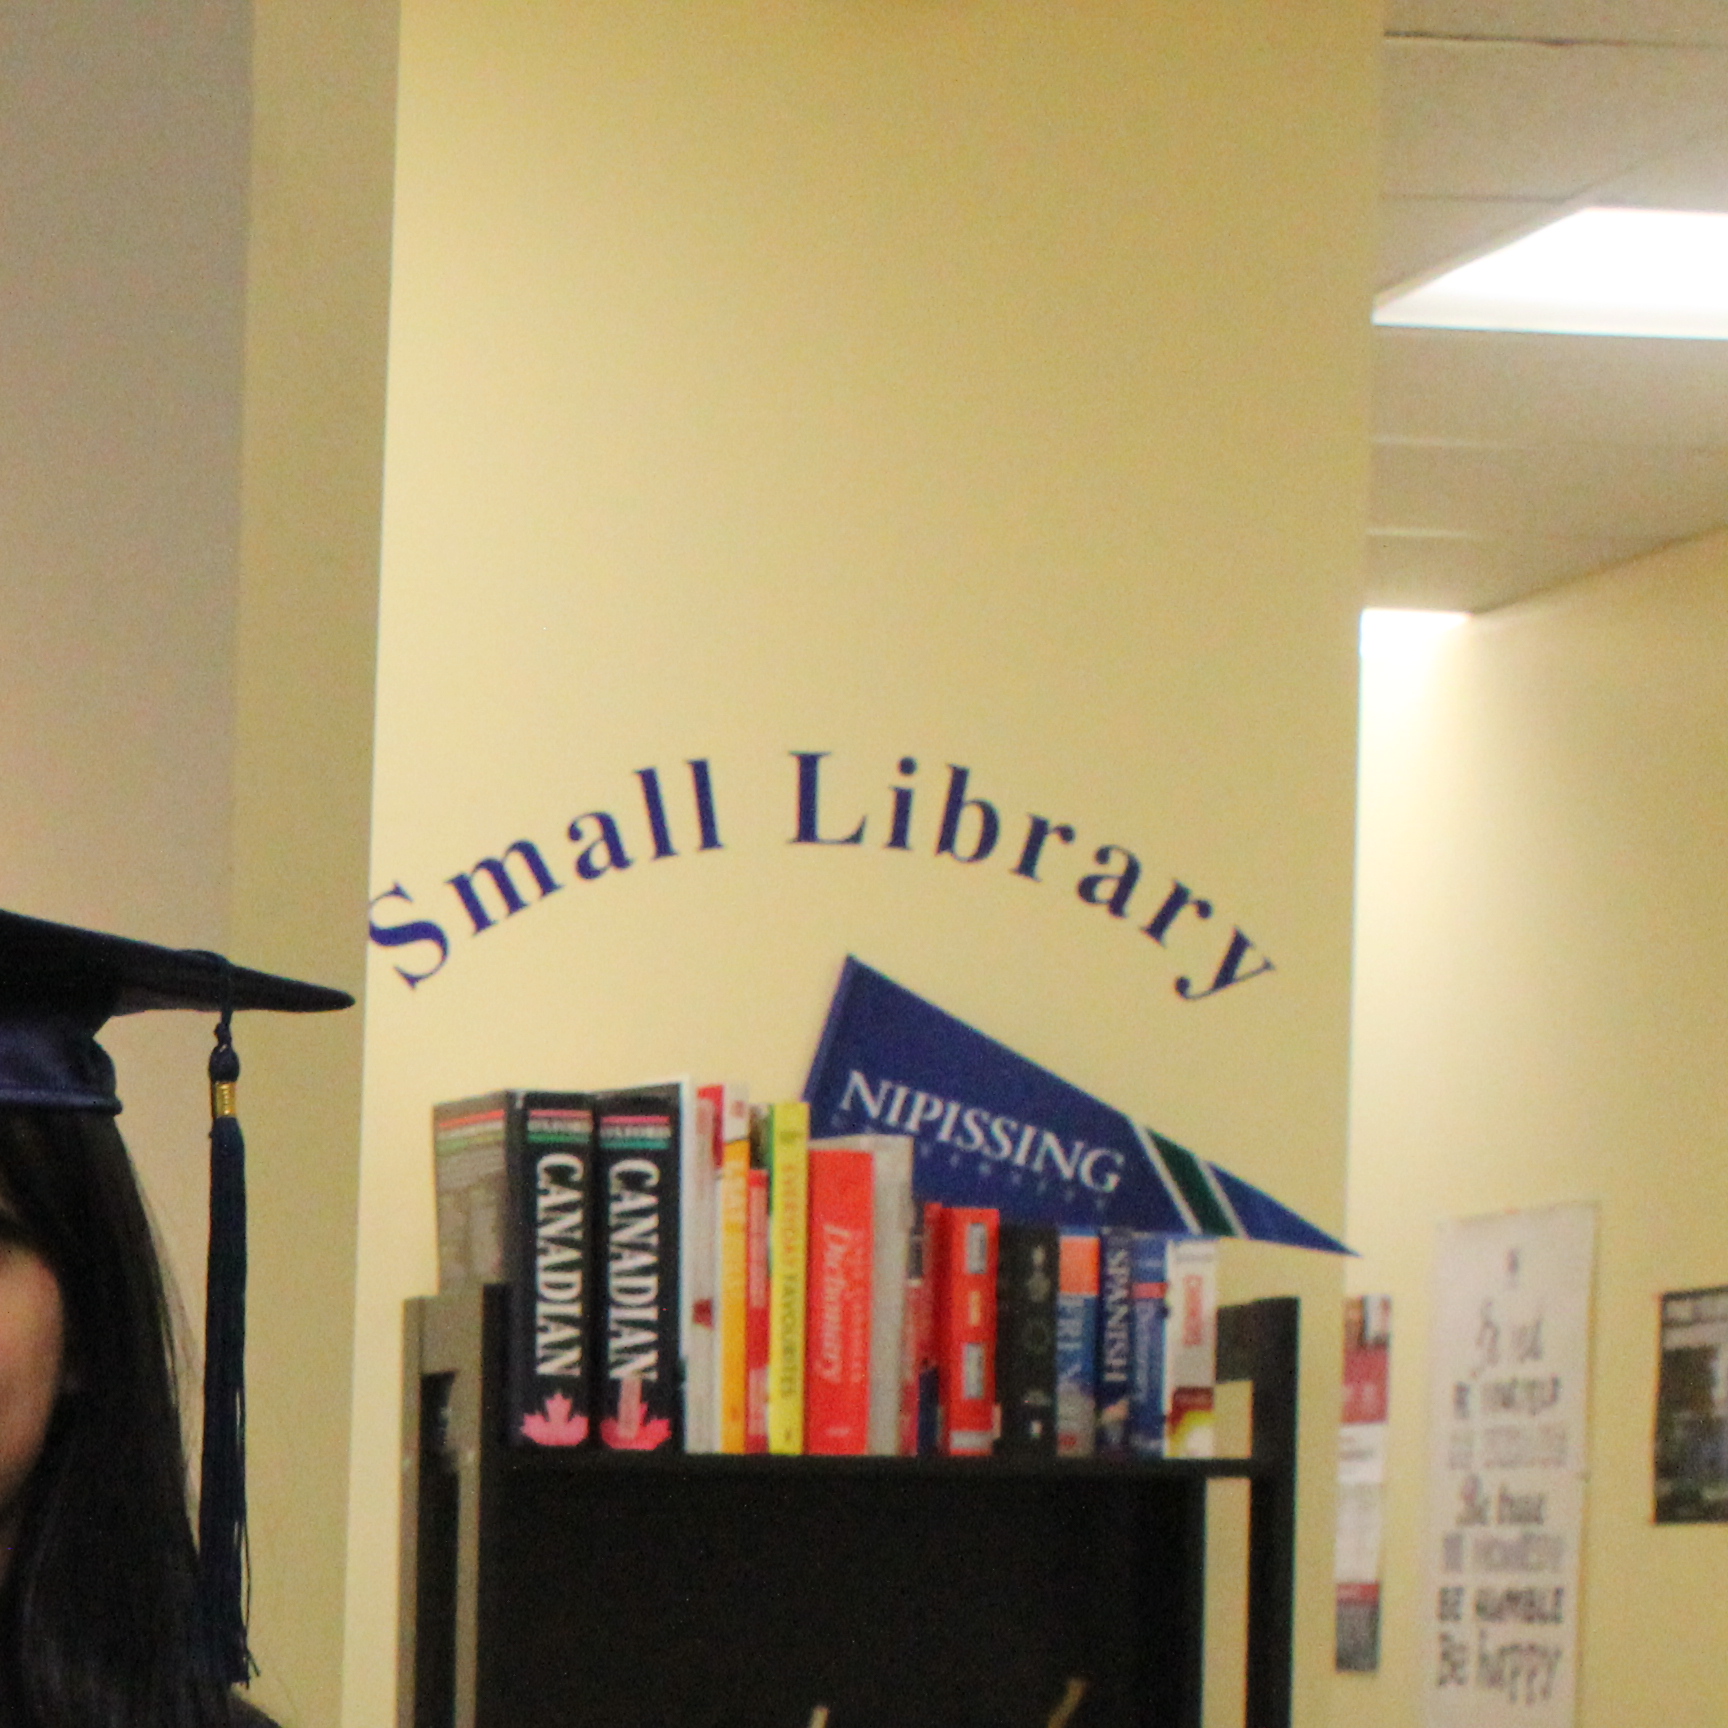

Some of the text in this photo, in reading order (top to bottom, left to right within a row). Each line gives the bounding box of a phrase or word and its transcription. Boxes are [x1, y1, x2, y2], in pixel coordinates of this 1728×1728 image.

[367, 751, 1277, 1001] Small Library
[837, 1069, 1127, 1198] NIPISSING
[535, 1153, 585, 1377] CANADIAN
[607, 1158, 660, 1383] CANADIAN
[780, 1272, 799, 1399] FAVOURITES
[812, 1223, 853, 1385] Dictionary
[1103, 1248, 1130, 1383] SPANISH
